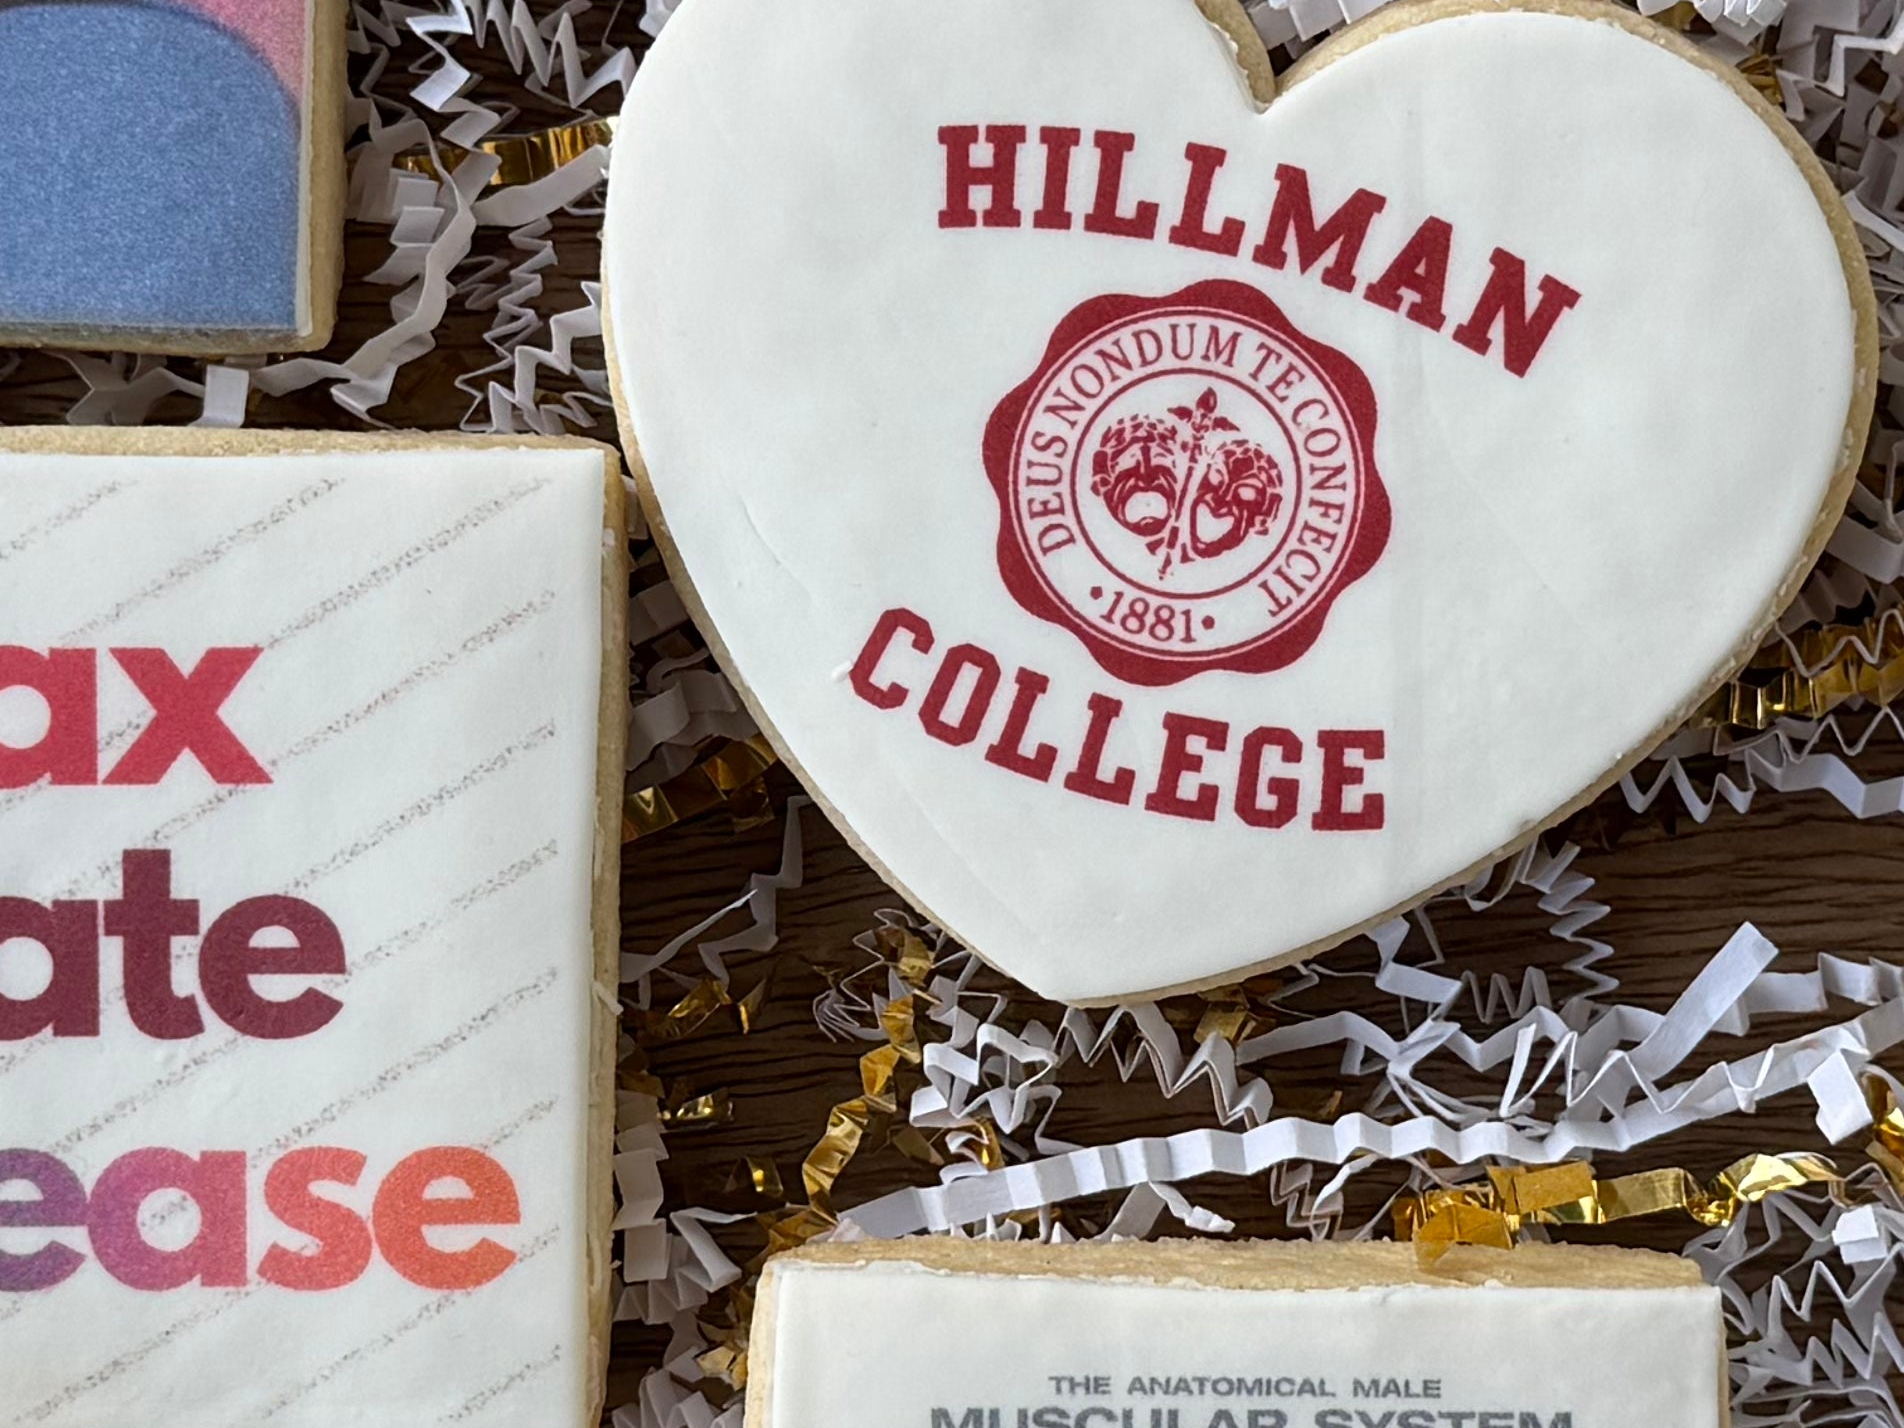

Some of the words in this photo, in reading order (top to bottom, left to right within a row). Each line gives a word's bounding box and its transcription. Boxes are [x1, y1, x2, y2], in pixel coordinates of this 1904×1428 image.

[937, 124, 1583, 379] HILLMAN
[1043, 323, 1243, 429] NONDUM
[1248, 341, 1305, 403] TE
[1026, 431, 1076, 556] DEUS
[1258, 397, 1348, 617] CONFECIT
[1099, 591, 1196, 643] 1881
[848, 607, 1387, 832] COLLEGE
[1048, 1375, 1113, 1397] THE
[1127, 1376, 1336, 1398] ANATOMICAL
[1353, 1377, 1442, 1399] MALE
